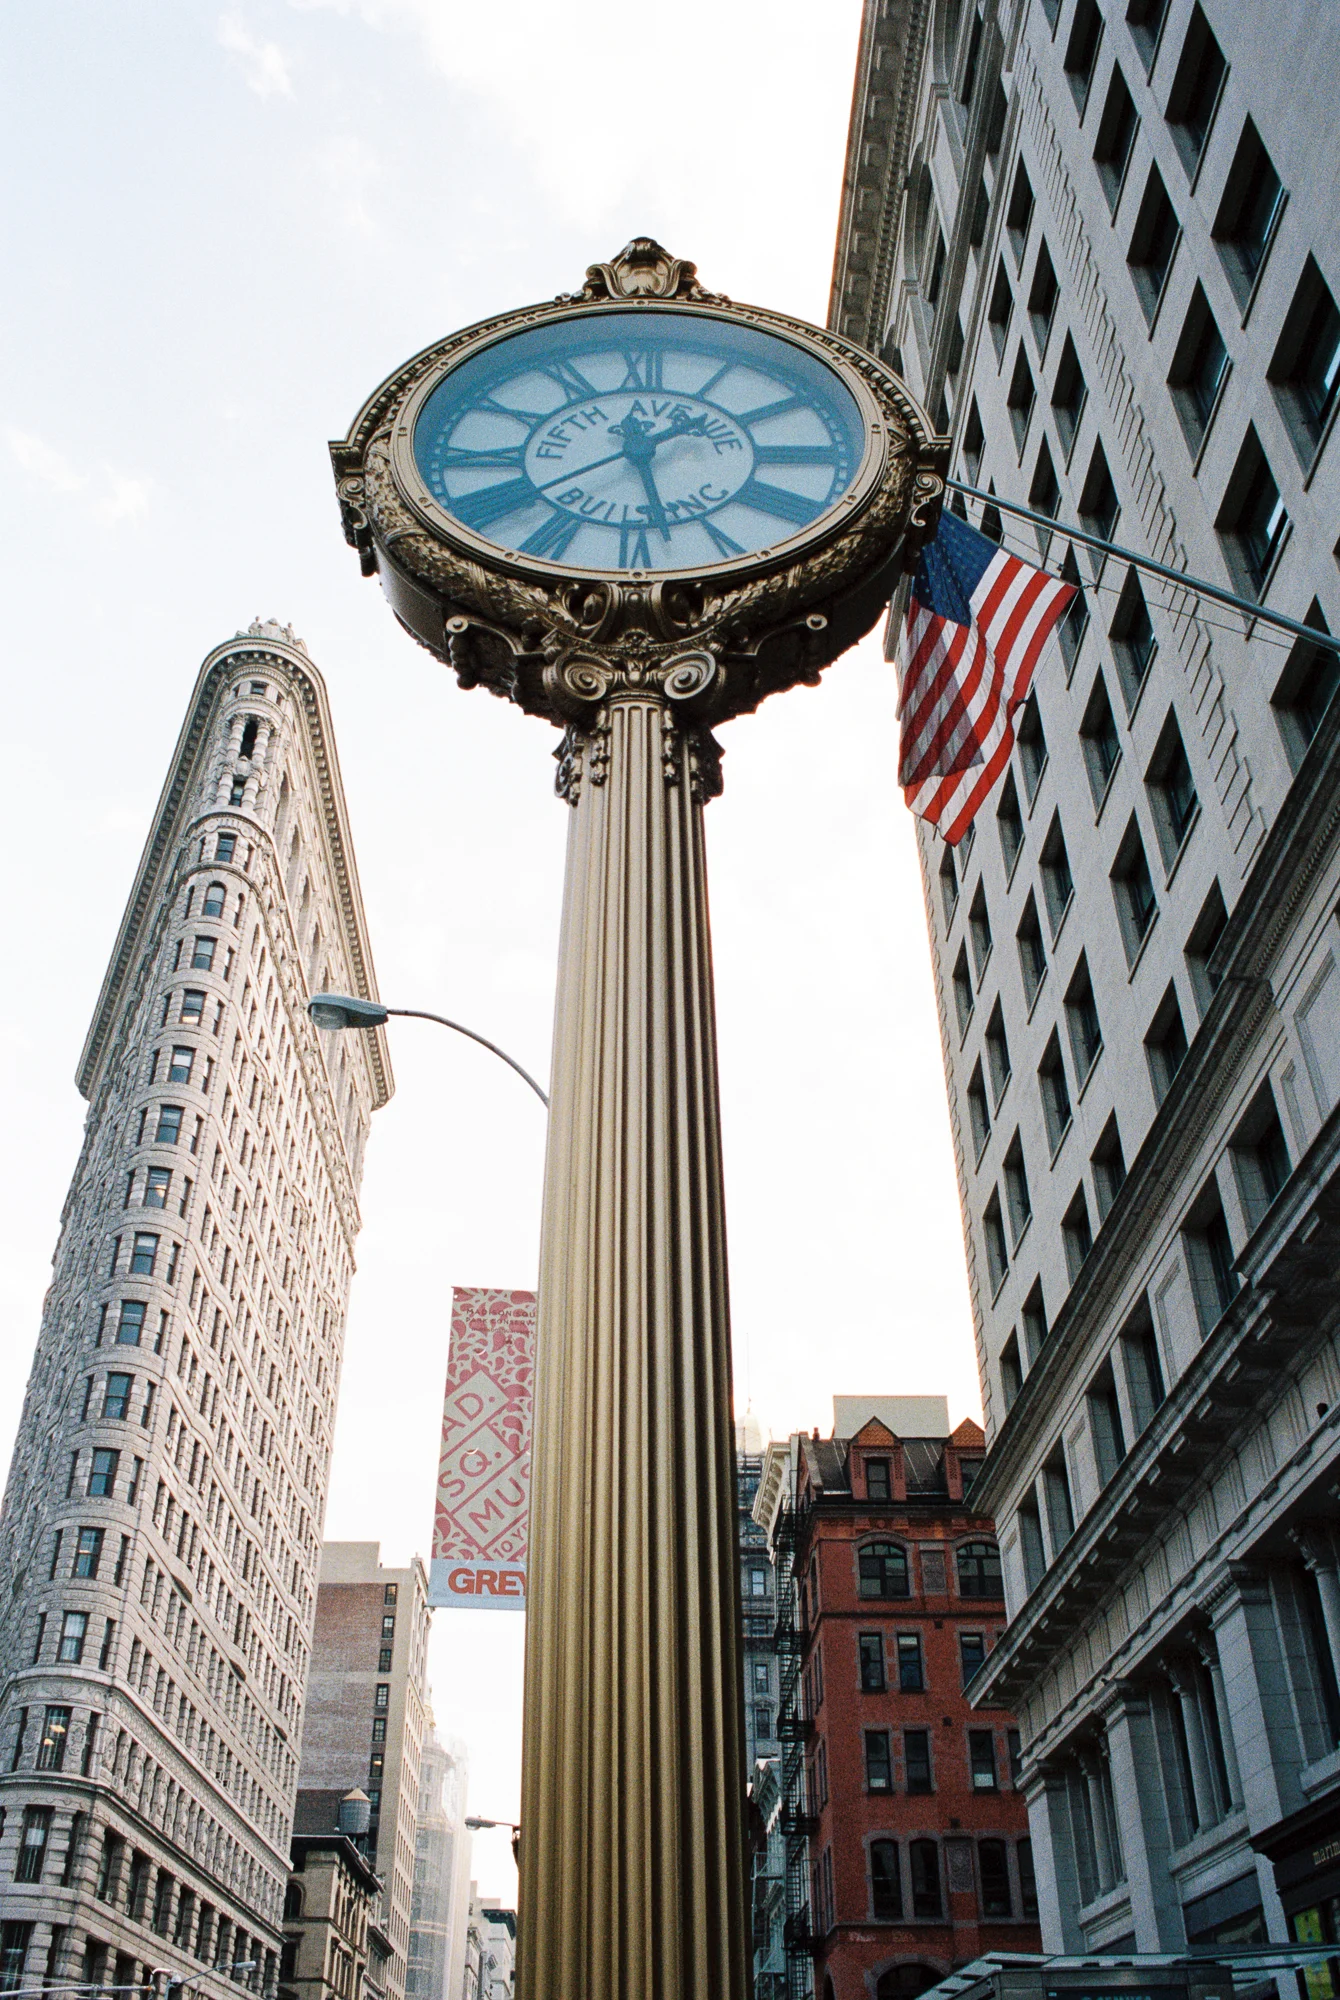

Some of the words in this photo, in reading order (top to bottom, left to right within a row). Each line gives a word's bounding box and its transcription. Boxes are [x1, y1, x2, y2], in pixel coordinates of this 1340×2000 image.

[623, 349, 662, 392] XII
[536, 406, 609, 459] FIFTH
[629, 400, 743, 455] AVENUE
[556, 483, 729, 524] BUILING
[466, 1308, 512, 1317] MADISON
[438, 1449, 502, 1498] SQ.
[493, 1540, 513, 1559] 10
